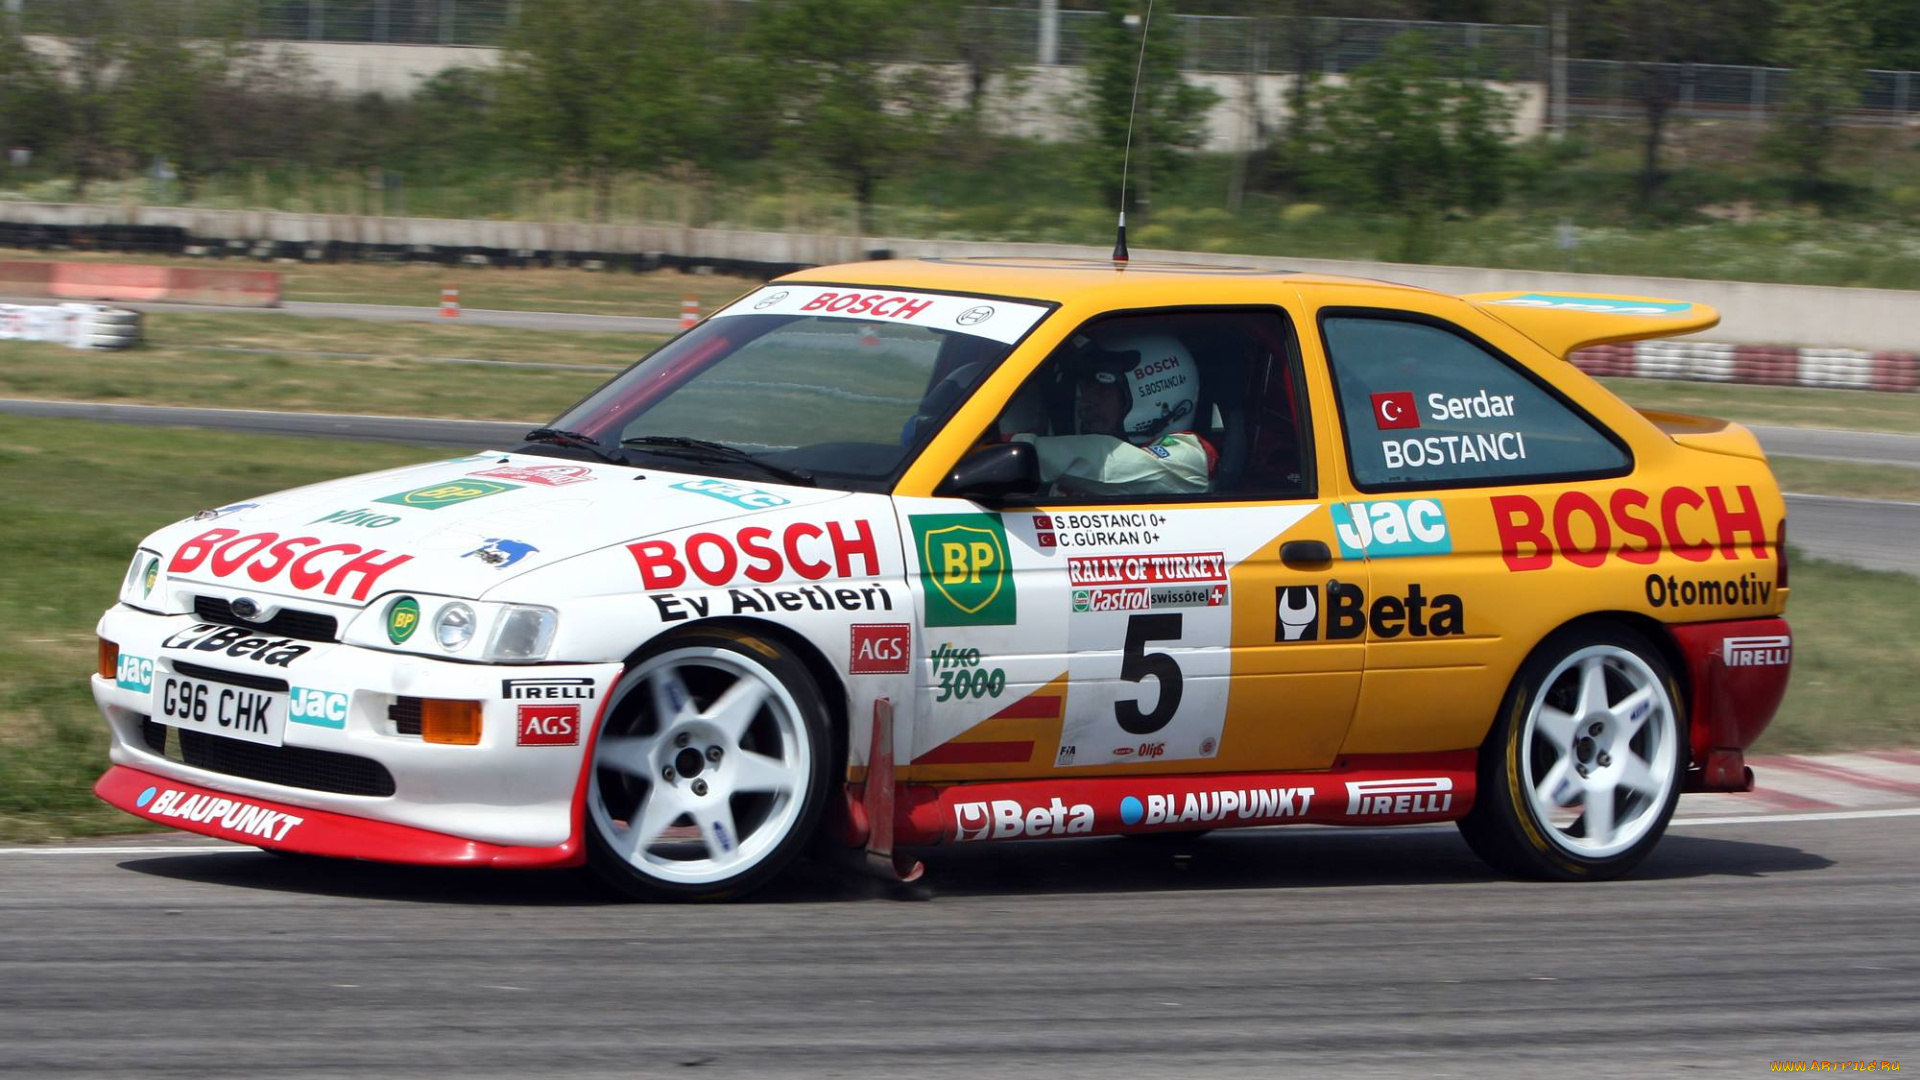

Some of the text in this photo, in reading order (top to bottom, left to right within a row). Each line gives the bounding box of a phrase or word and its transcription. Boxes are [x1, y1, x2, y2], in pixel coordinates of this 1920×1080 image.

[800, 292, 935, 319] BOSCH
[1132, 355, 1180, 380] BOSCH
[1428, 390, 1515, 421] Serdar
[1382, 431, 1526, 469] BOSTANCI
[416, 486, 483, 498] BP
[1054, 513, 1146, 530] S.BOSTANCI
[1059, 530, 1140, 547] C.GÜRKAN
[1489, 485, 1771, 573] BOSCH
[167, 527, 415, 602] BOSCH
[624, 519, 881, 590] BOSCH
[941, 541, 995, 585] BP
[1069, 555, 1223, 583] RALLY OF TURKEY
[648, 582, 893, 622] Ev Aletleri
[1089, 588, 1150, 611] Castrol
[1151, 588, 1209, 604] swissôtel
[1645, 572, 1772, 607] Otomotiv
[395, 612, 415, 628] BP
[1326, 582, 1466, 640] Beta
[193, 625, 312, 668] Beta
[858, 637, 902, 661] AGS
[1723, 635, 1790, 666] PIRELLI
[502, 678, 595, 699] PIRELLI
[936, 668, 1006, 703] 3000
[1114, 613, 1183, 734] 5
[164, 678, 273, 735] G96 CHK
[525, 716, 572, 736] AGS
[1144, 787, 1316, 824] BLAUPUNKT
[1345, 777, 1453, 816] PIRELLI
[149, 789, 304, 842] BLAUPUNKT
[992, 797, 1095, 838] Beta
